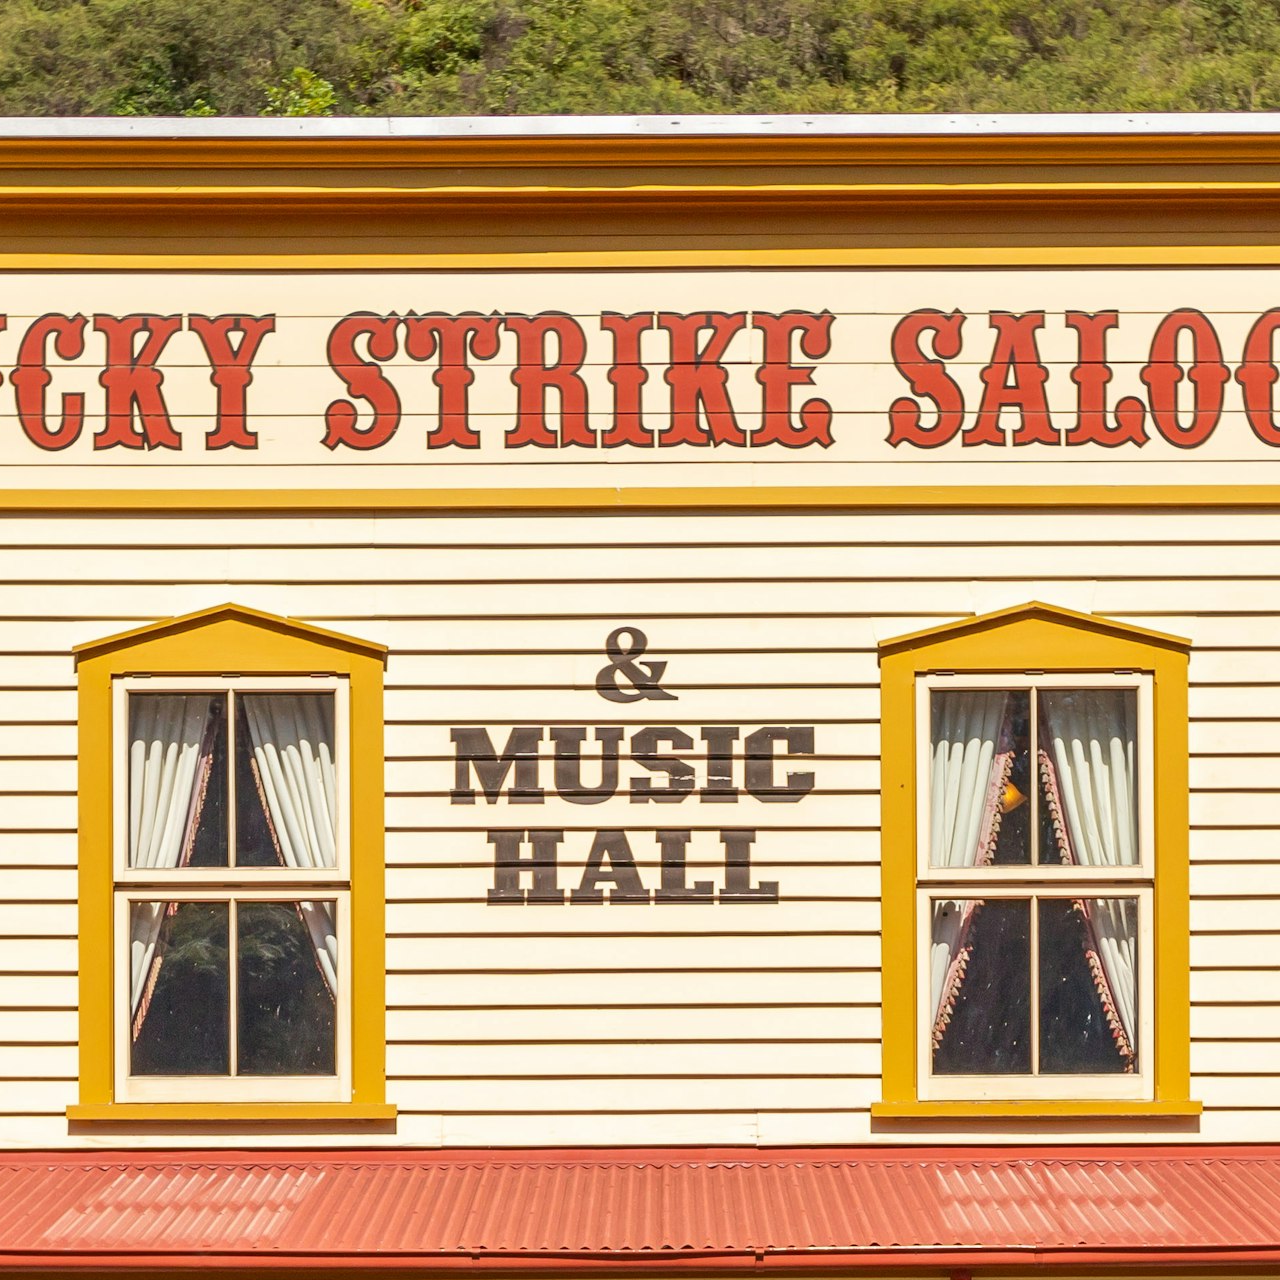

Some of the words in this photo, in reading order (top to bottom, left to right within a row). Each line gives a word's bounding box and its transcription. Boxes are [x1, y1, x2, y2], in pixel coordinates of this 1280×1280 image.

[321, 309, 836, 452] STRIKE
[595, 626, 679, 703] &
[450, 726, 815, 805] MUSIC
[487, 828, 779, 905] HALL
